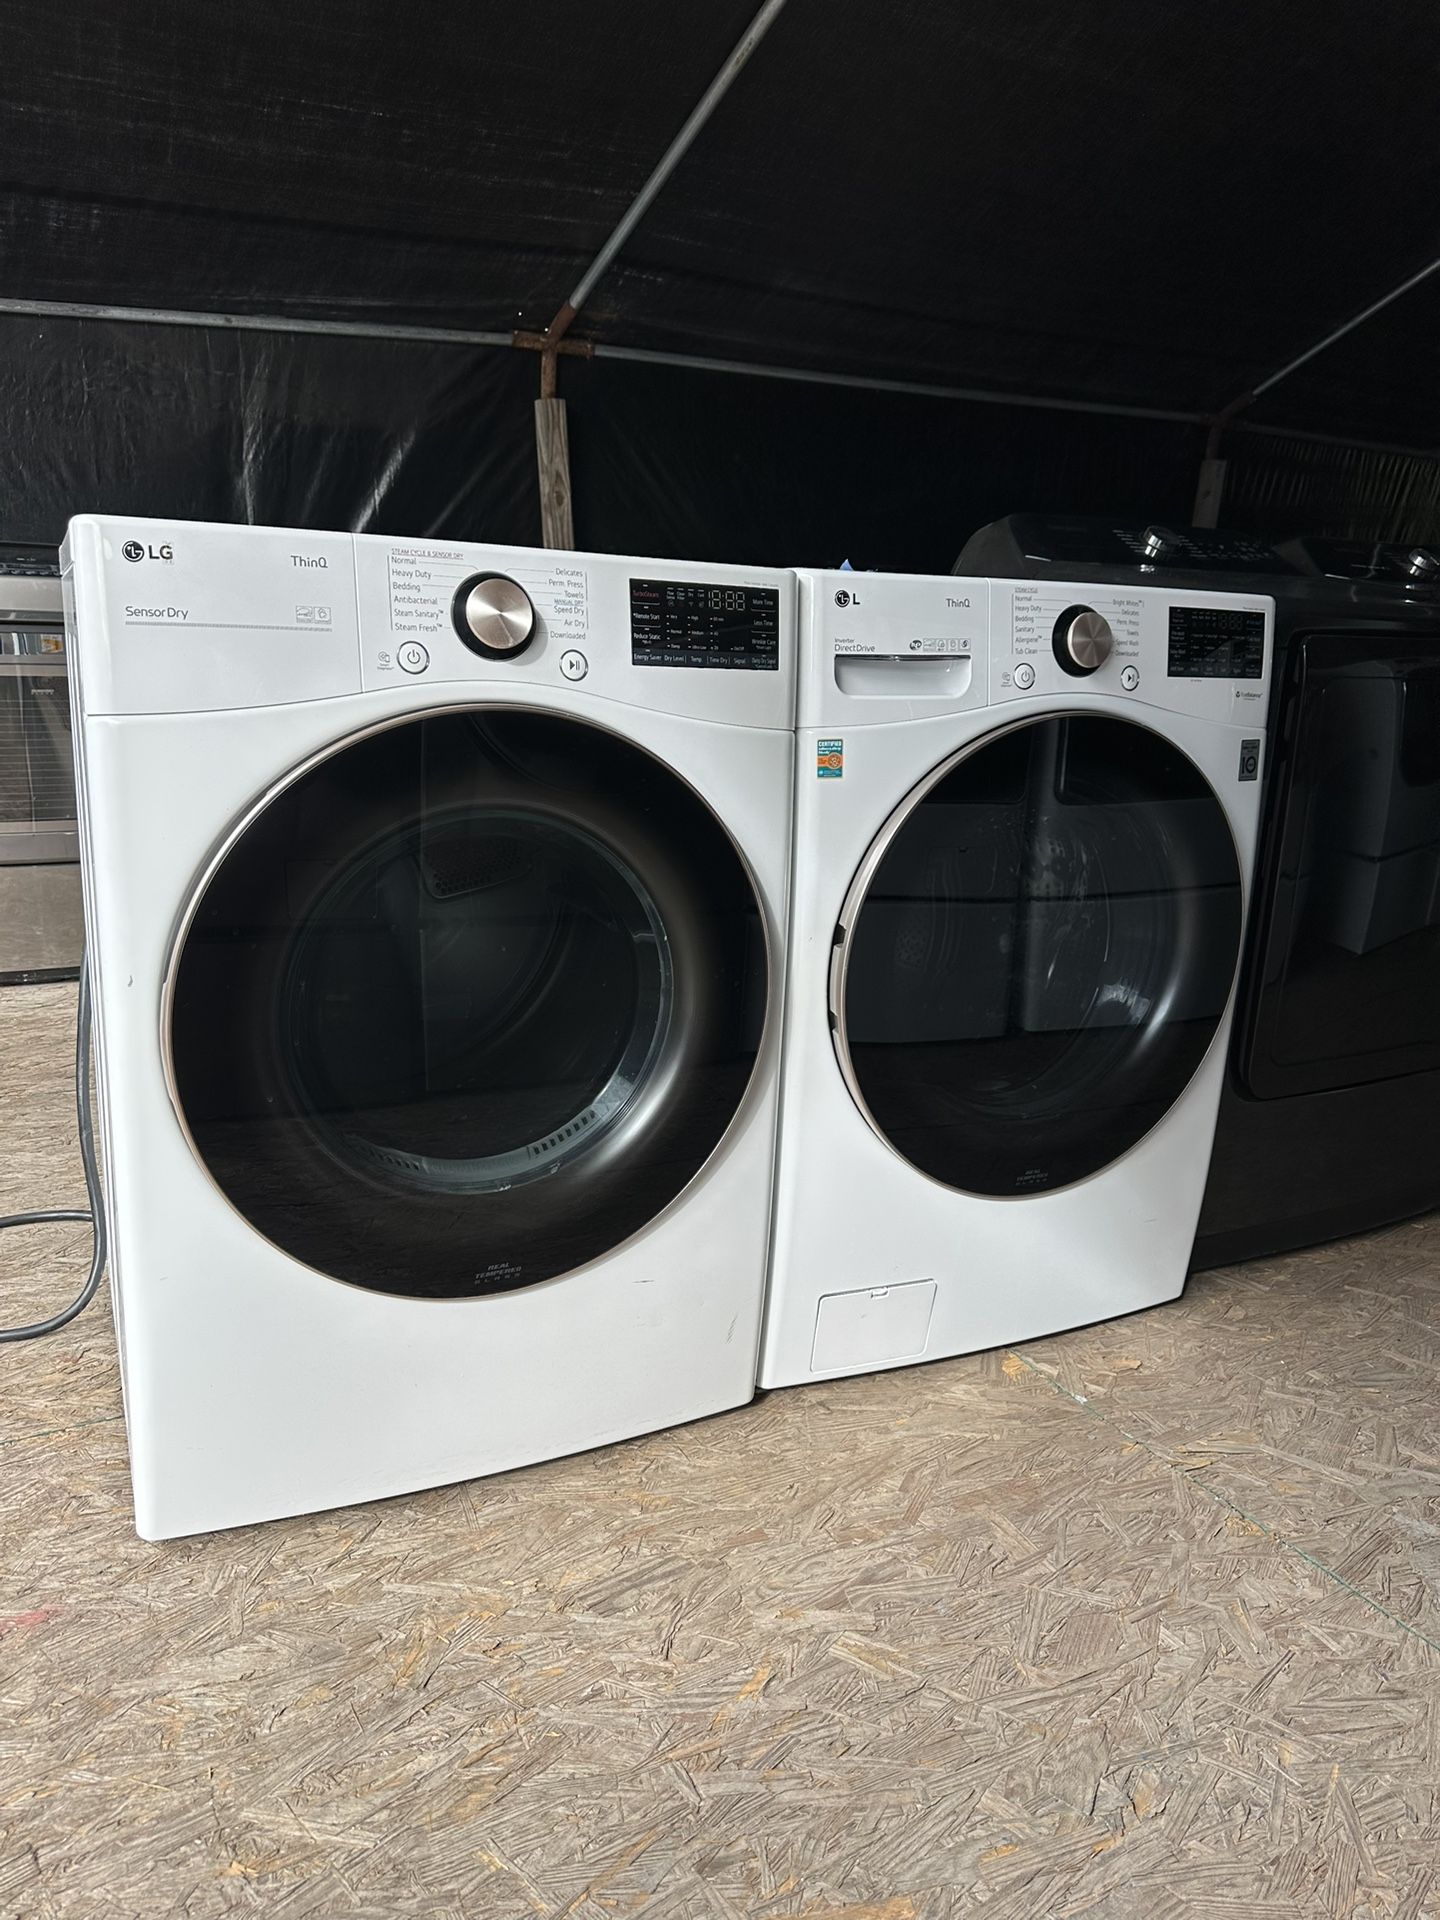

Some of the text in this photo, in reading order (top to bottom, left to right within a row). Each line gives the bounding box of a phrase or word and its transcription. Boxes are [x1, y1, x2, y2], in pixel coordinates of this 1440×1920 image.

[148, 545, 173, 560] LG
[290, 555, 328, 568] ThinQ
[392, 569, 431, 580] Heavy Duty
[556, 568, 583, 577] Delicates
[393, 582, 420, 592] Bedding
[567, 580, 584, 588] Press
[564, 590, 584, 599] Towels
[394, 596, 438, 605] Antibacterial
[946, 599, 970, 607] ThinQ
[554, 606, 584, 616] Speed Dry
[1015, 615, 1034, 623] Bedding
[395, 623, 417, 631] Steam
[574, 620, 585, 629] Dry
[550, 631, 586, 640] Downloaded
